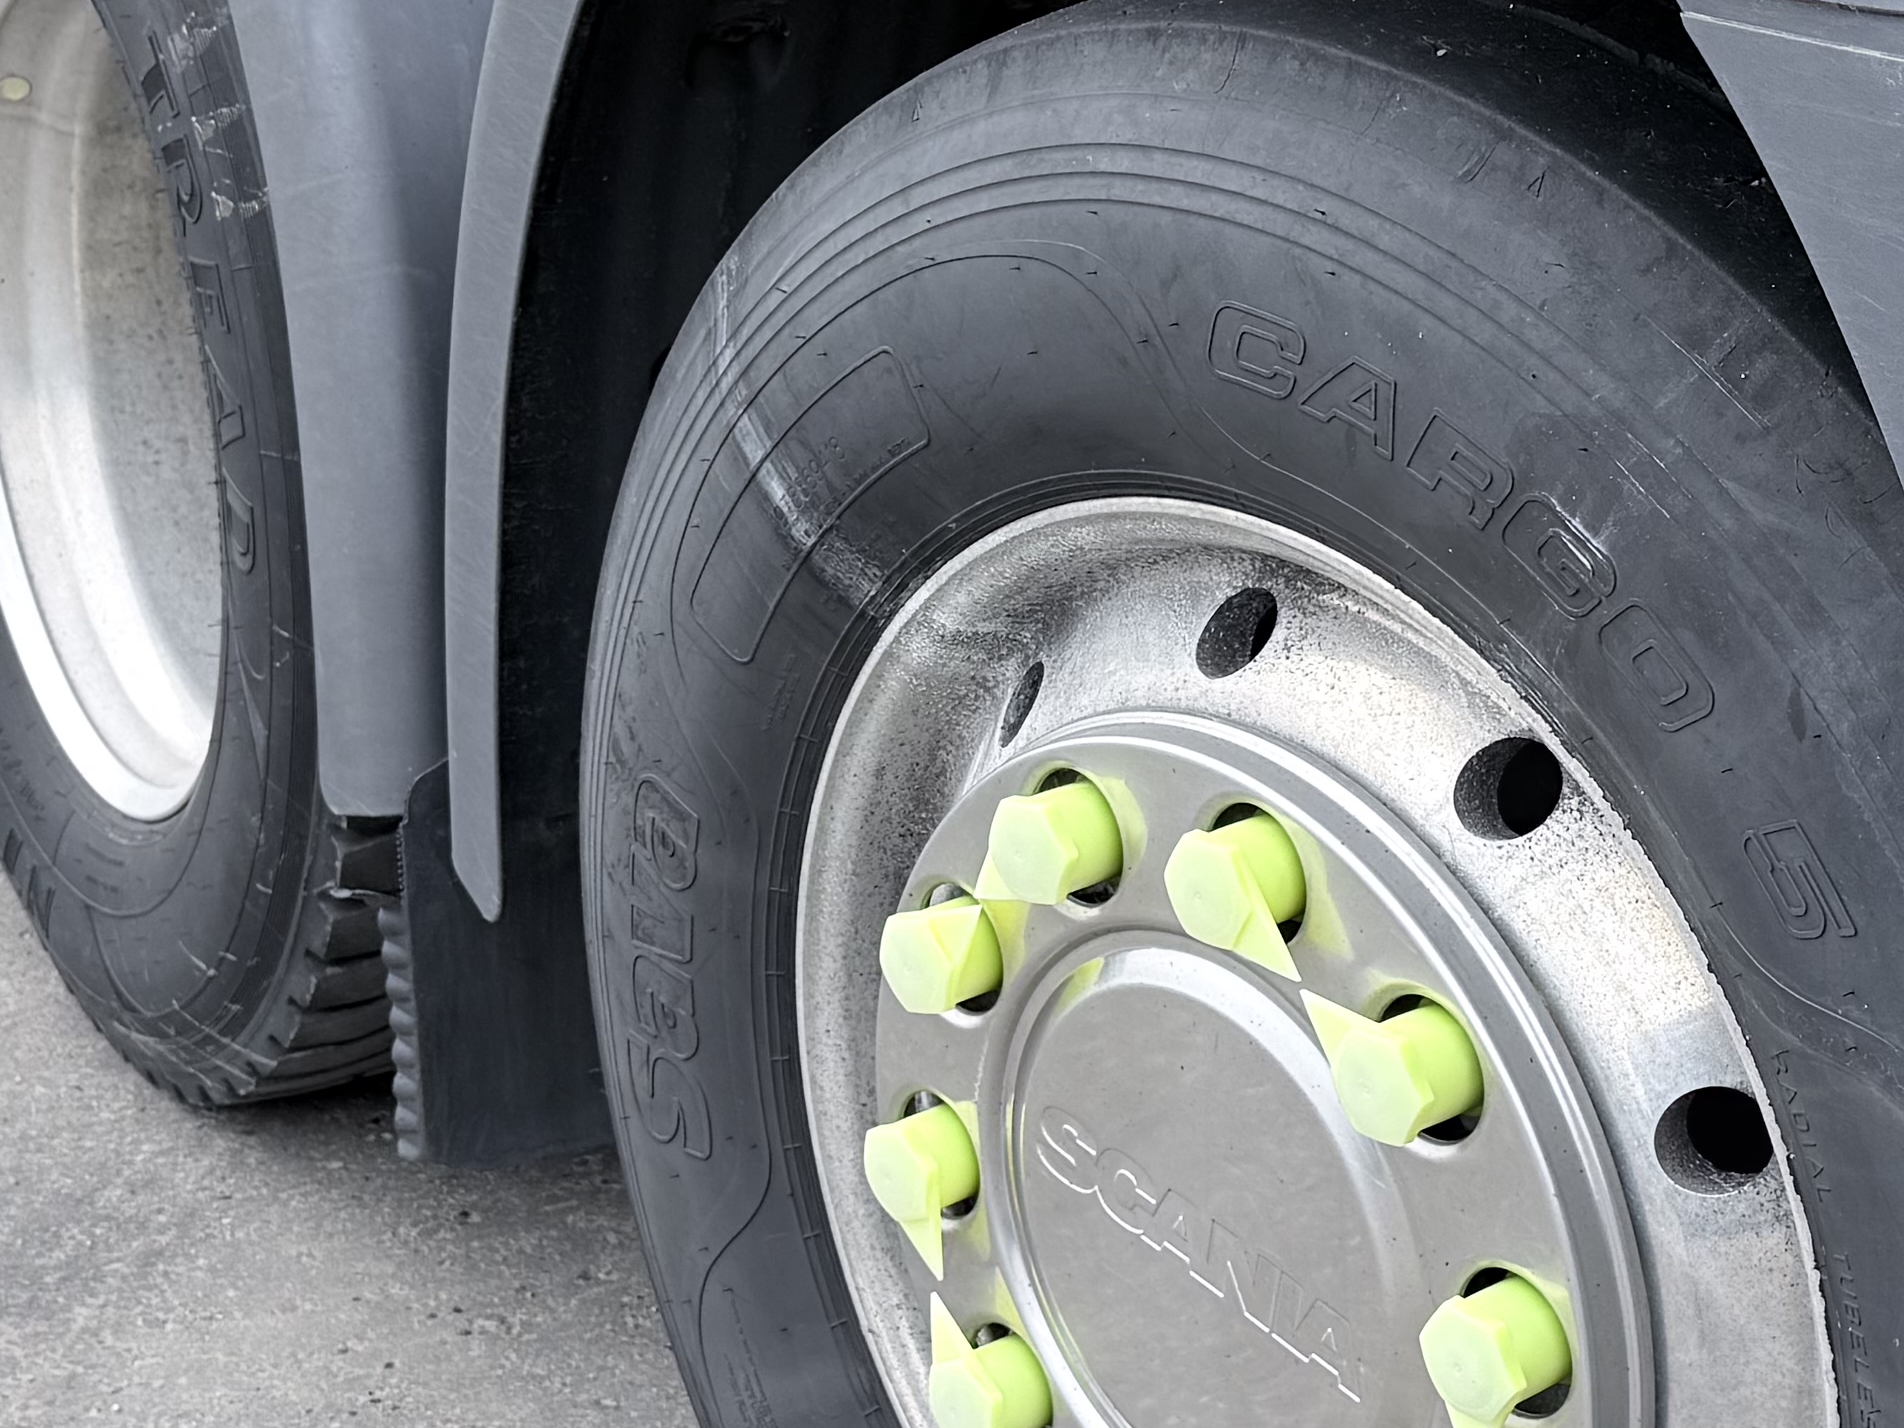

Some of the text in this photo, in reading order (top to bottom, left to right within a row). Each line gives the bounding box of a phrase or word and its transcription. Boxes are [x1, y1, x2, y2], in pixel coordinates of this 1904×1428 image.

[139, 30, 256, 573] TREAD
[1206, 298, 1857, 943] CARGO 5
[1035, 1104, 1367, 1404] SCANIA
[1769, 1048, 1832, 1204] RADIAL
